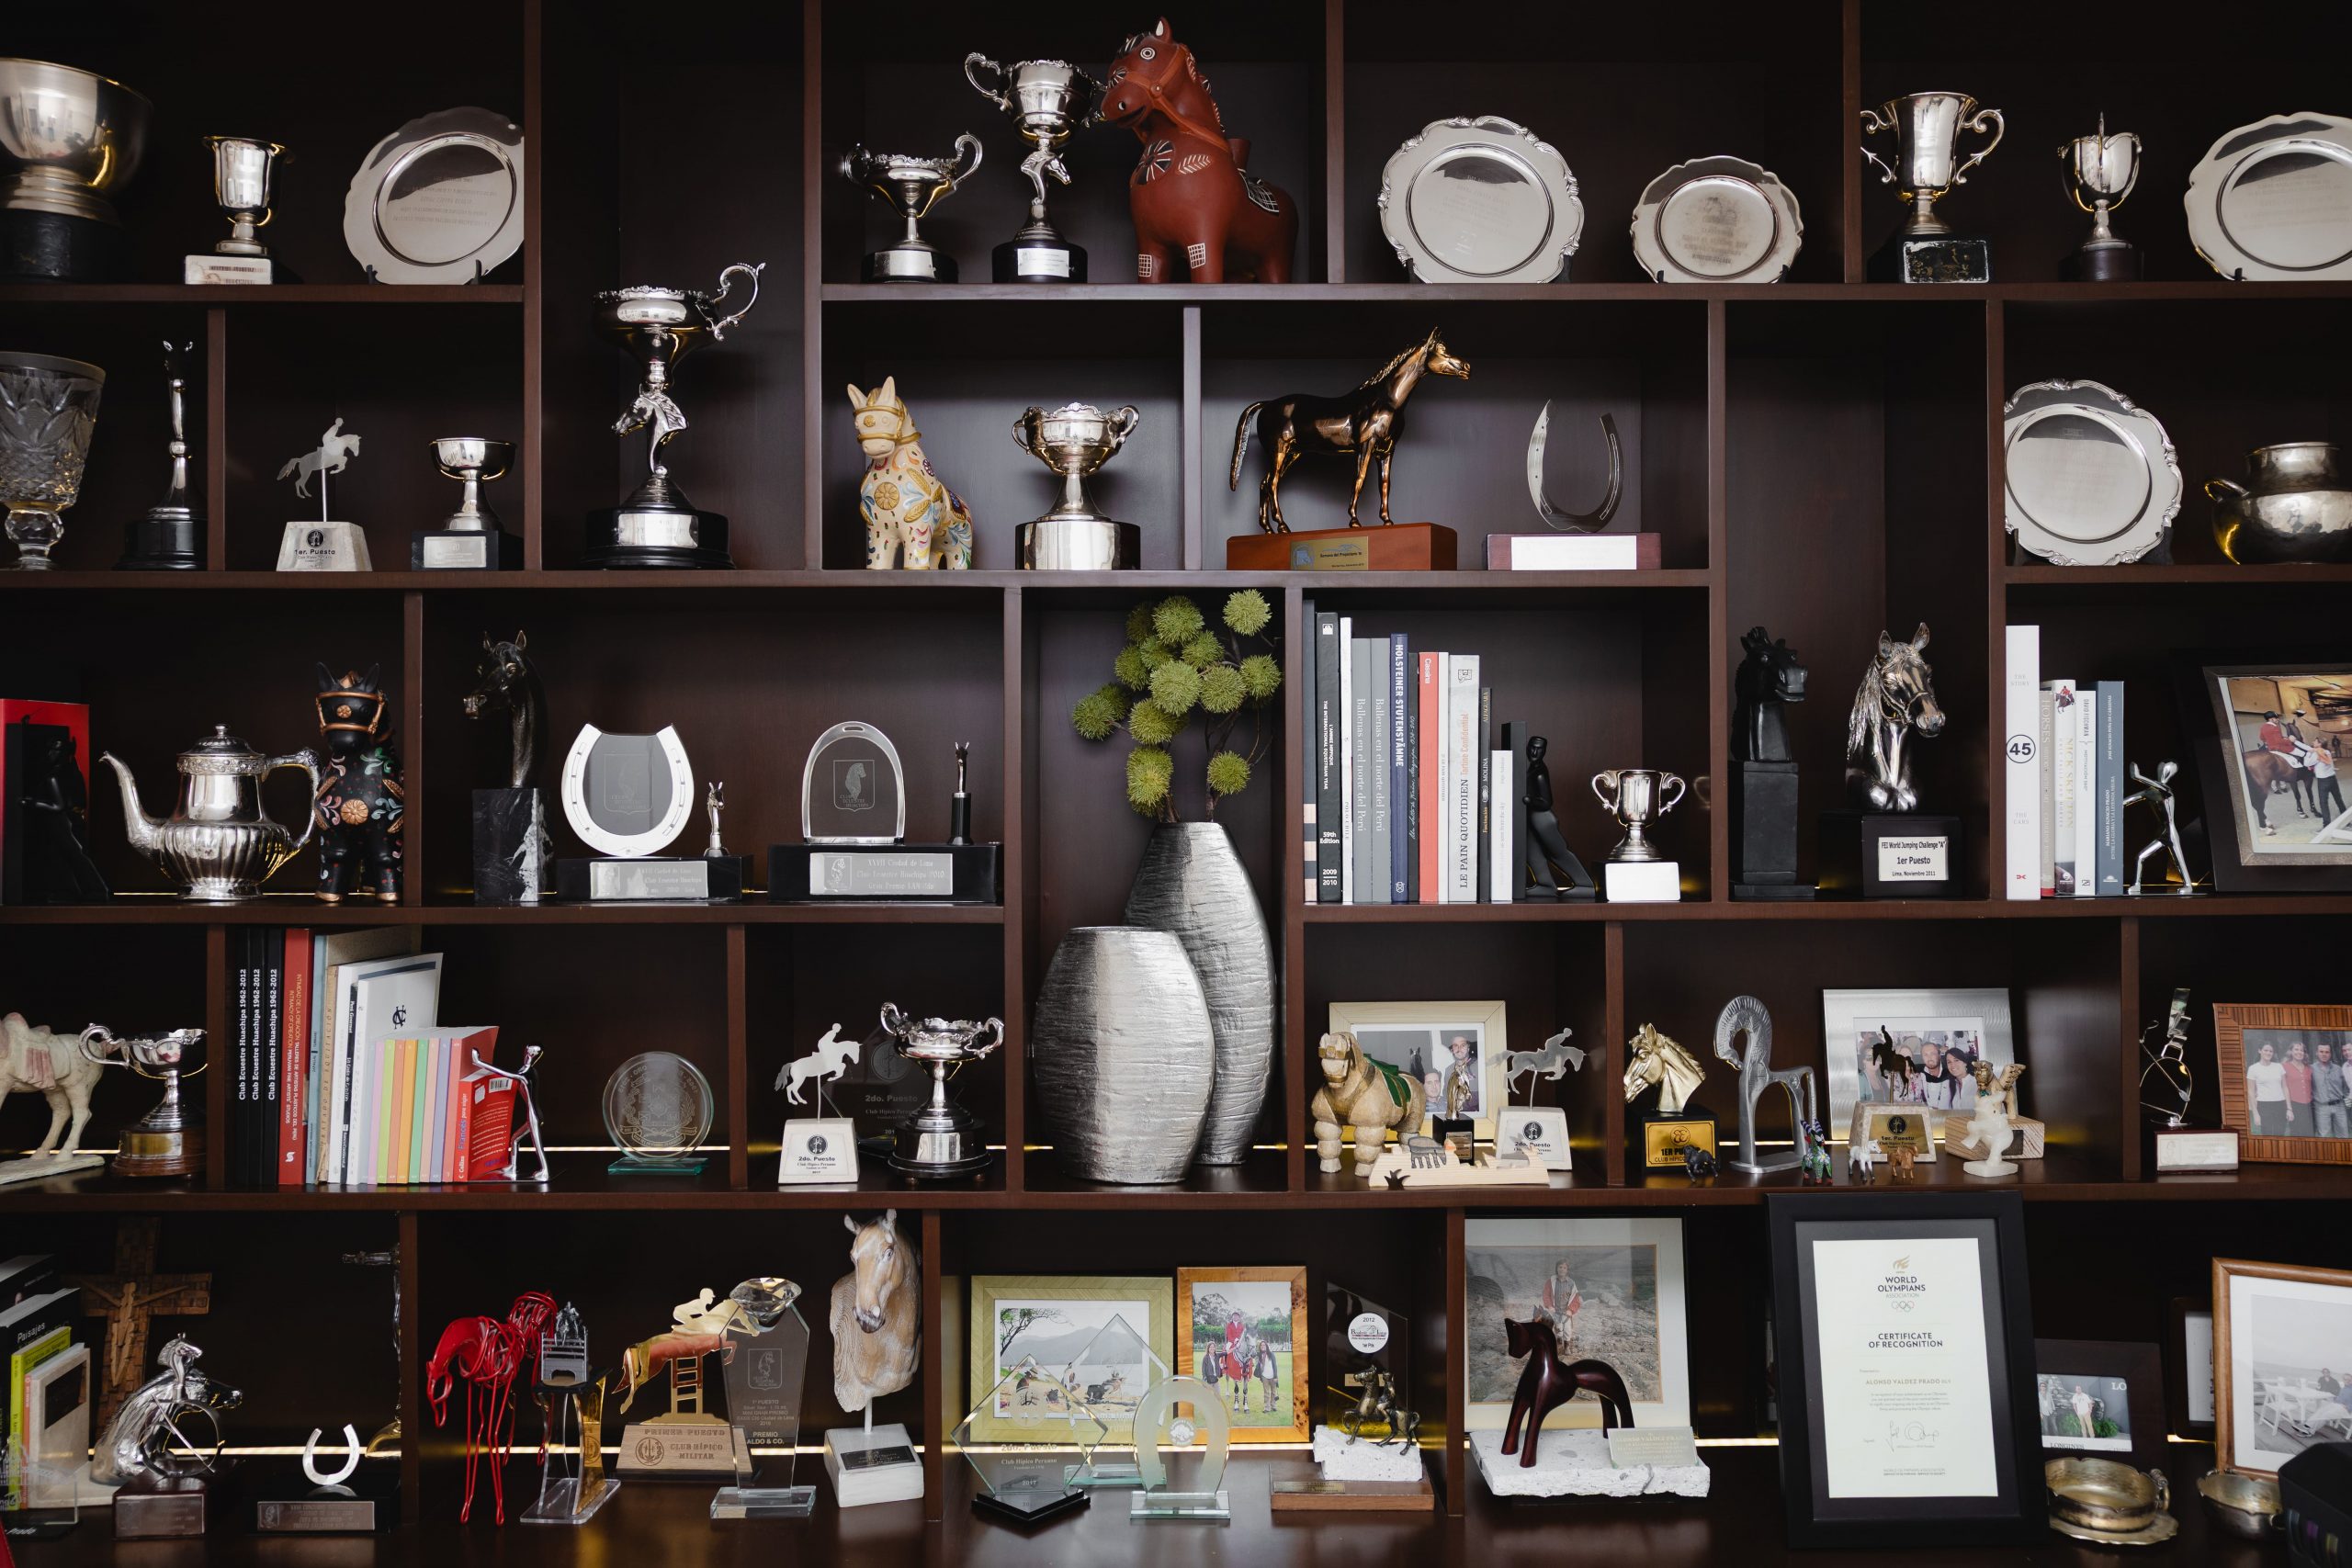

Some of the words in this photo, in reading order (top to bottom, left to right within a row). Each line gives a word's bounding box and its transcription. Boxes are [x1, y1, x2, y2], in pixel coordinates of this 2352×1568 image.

[1395, 644, 1404, 696] HOLSTEINER
[1424, 658, 1432, 684] Cassina
[1356, 698, 1366, 738] Ballenas
[1375, 698, 1385, 738] Ballenas
[2042, 699, 2051, 743] HORSES
[1395, 699, 1405, 767] STUTENSTÄMME
[1461, 714, 1469, 752] Confidential
[1356, 739, 1363, 751] en
[1375, 739, 1383, 751] en
[2009, 742, 2031, 756] 45
[1356, 754, 1366, 762] el
[1375, 754, 1385, 762] el
[2064, 738, 2074, 768] NICK
[1356, 793, 1366, 807] del
[1375, 793, 1385, 807] del
[2064, 772, 2074, 829] SKELTON
[1459, 779, 1469, 841] QUOTIDIEN
[1356, 810, 1366, 831] Perú
[1375, 810, 1385, 831] Perú
[1901, 841, 1918, 850] Jumping
[1918, 841, 1938, 850] Challenge
[1459, 843, 1468, 871] PAIN
[1897, 856, 1908, 864] 1er
[1909, 856, 1931, 864] Puesto
[1459, 874, 1468, 888] LE
[295, 998, 301, 1007] DE
[239, 1009, 247, 1046] Huachipa
[252, 1009, 260, 1046] Huachipa
[268, 1009, 277, 1046] Huachipa
[865, 1094, 884, 1102] 2do.
[887, 1094, 918, 1102] Puesto
[458, 1120, 466, 1150] Francés
[1885, 1276, 1917, 1284] WORLD
[1877, 1284, 1927, 1292] OLYMPIANS
[17, 1323, 46, 1344] Paisajes
[1878, 1332, 1932, 1340] CERTIFICATE
[1882, 1340, 1943, 1348] RECOGNITION
[2110, 1382, 2127, 1391] LO
[693, 1442, 723, 1450] HÍPICO
[1001, 1443, 1022, 1451] 2do.
[1023, 1443, 1057, 1451] Puesto
